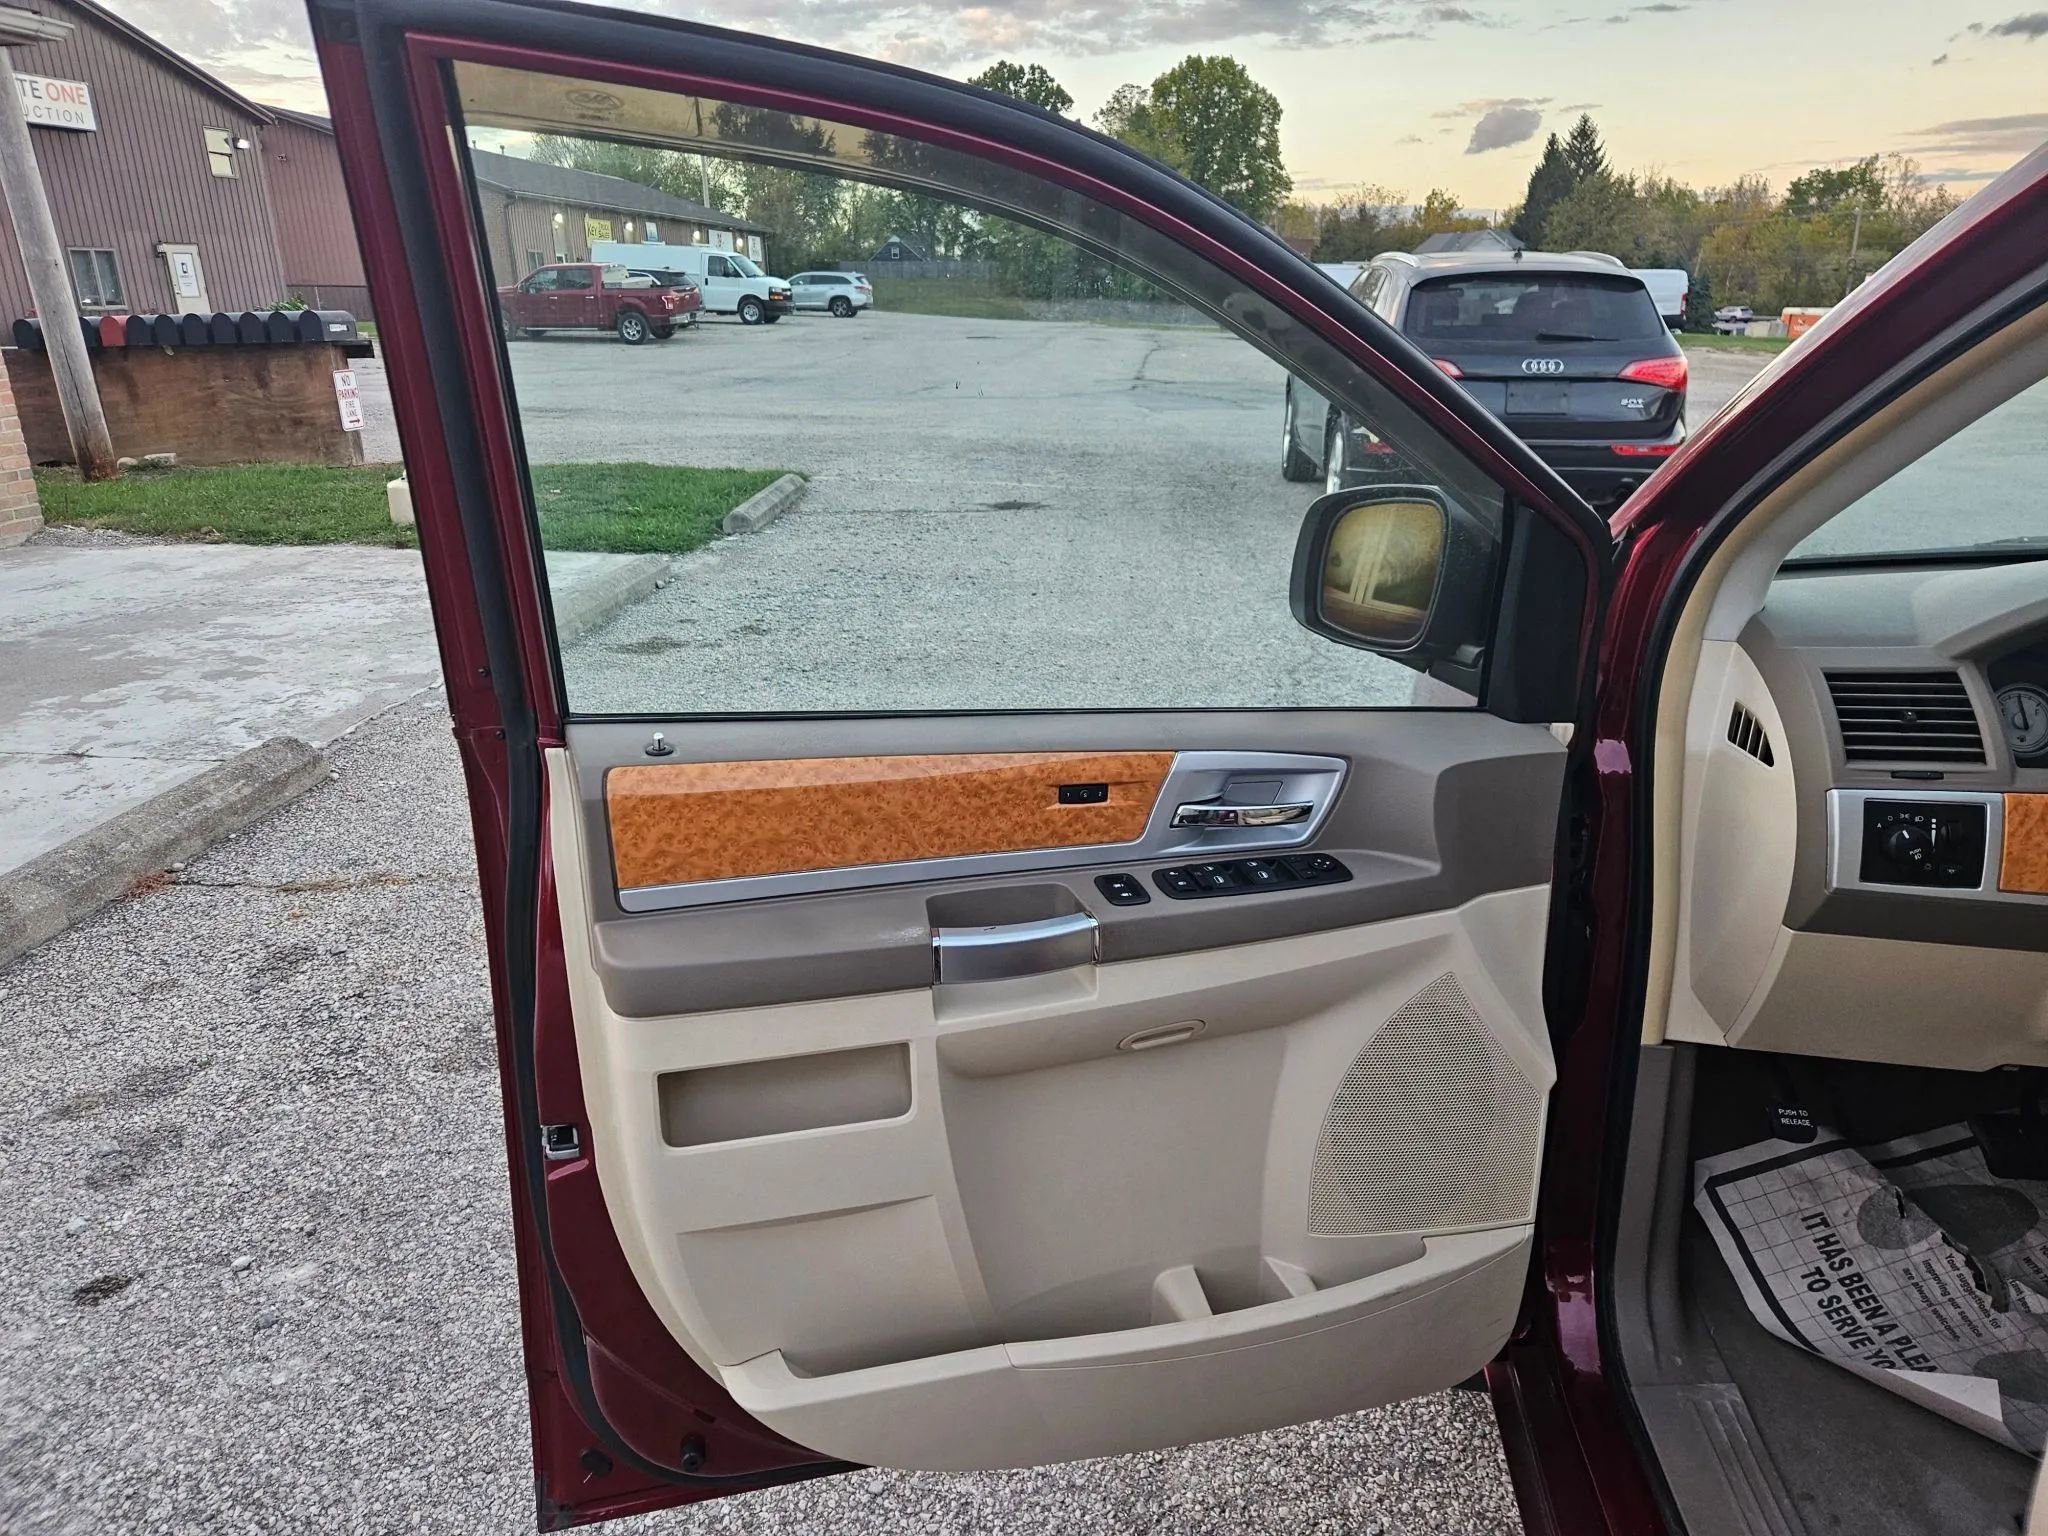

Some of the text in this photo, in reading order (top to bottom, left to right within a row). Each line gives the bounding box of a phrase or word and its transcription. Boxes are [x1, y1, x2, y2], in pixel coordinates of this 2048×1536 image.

[45, 82, 88, 105] ONE
[341, 375, 351, 387] NO
[338, 387, 359, 399] PARKING
[345, 400, 356, 409] FIRE
[346, 409, 358, 418] LANE
[1778, 1108, 1809, 1117] PUSH TO
[1780, 1117, 1811, 1127] RELEASE
[1801, 1211, 1830, 1230] IT
[1813, 1232, 1853, 1272] HAS
[1837, 1271, 1889, 1321] BEEN
[1902, 1267, 1915, 1280] are
[1911, 1281, 1935, 1308] always
[1945, 1252, 2001, 1329] Your suggestions for
[1801, 1266, 1831, 1292] TO
[1817, 1294, 1876, 1350] SERVE
[1947, 1297, 1962, 1310] our
[1958, 1310, 1983, 1338] service
[1872, 1323, 1899, 1337] A
